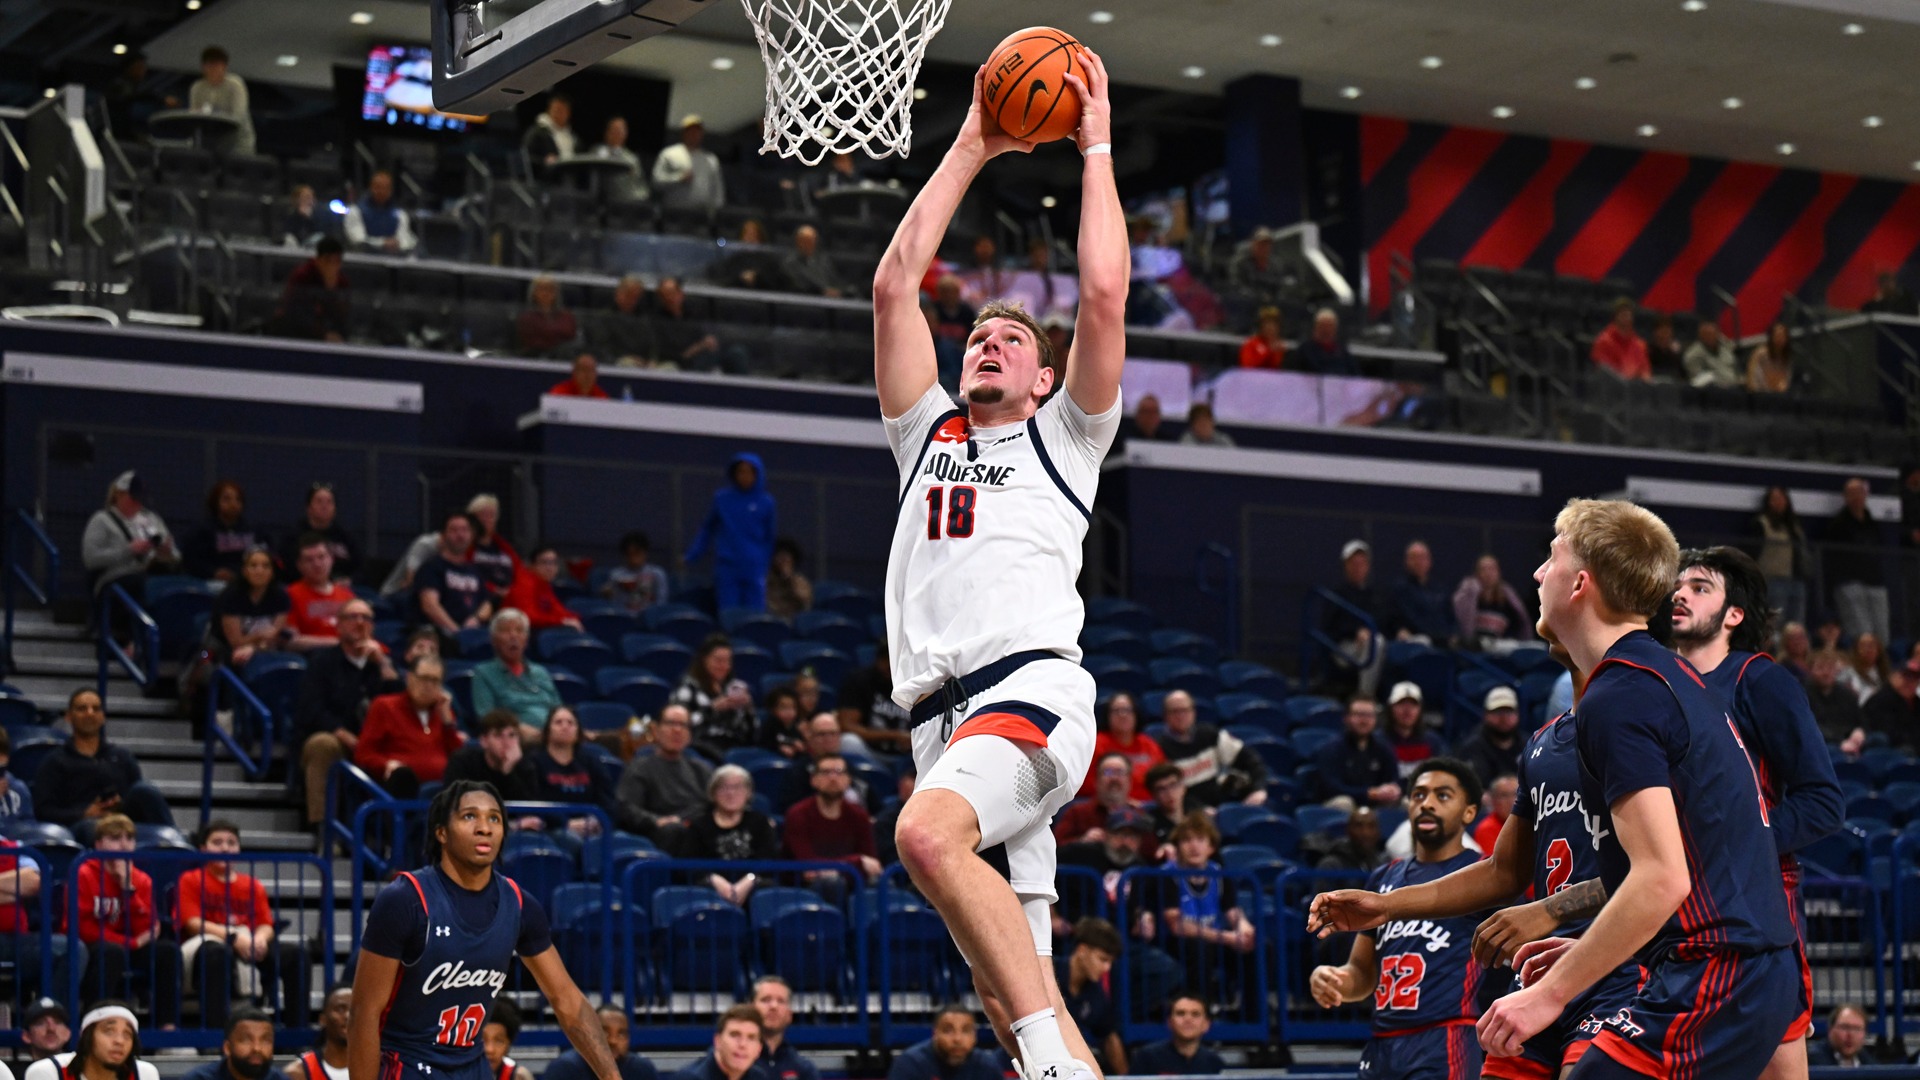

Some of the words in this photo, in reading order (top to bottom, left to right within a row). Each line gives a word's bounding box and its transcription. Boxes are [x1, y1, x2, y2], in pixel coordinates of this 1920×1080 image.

[986, 52, 1025, 104] ELITE
[925, 485, 978, 541] 18
[1546, 837, 1574, 897] 2
[422, 960, 507, 999] Cleary
[1374, 951, 1427, 1011] 52
[436, 1002, 486, 1047] 10
